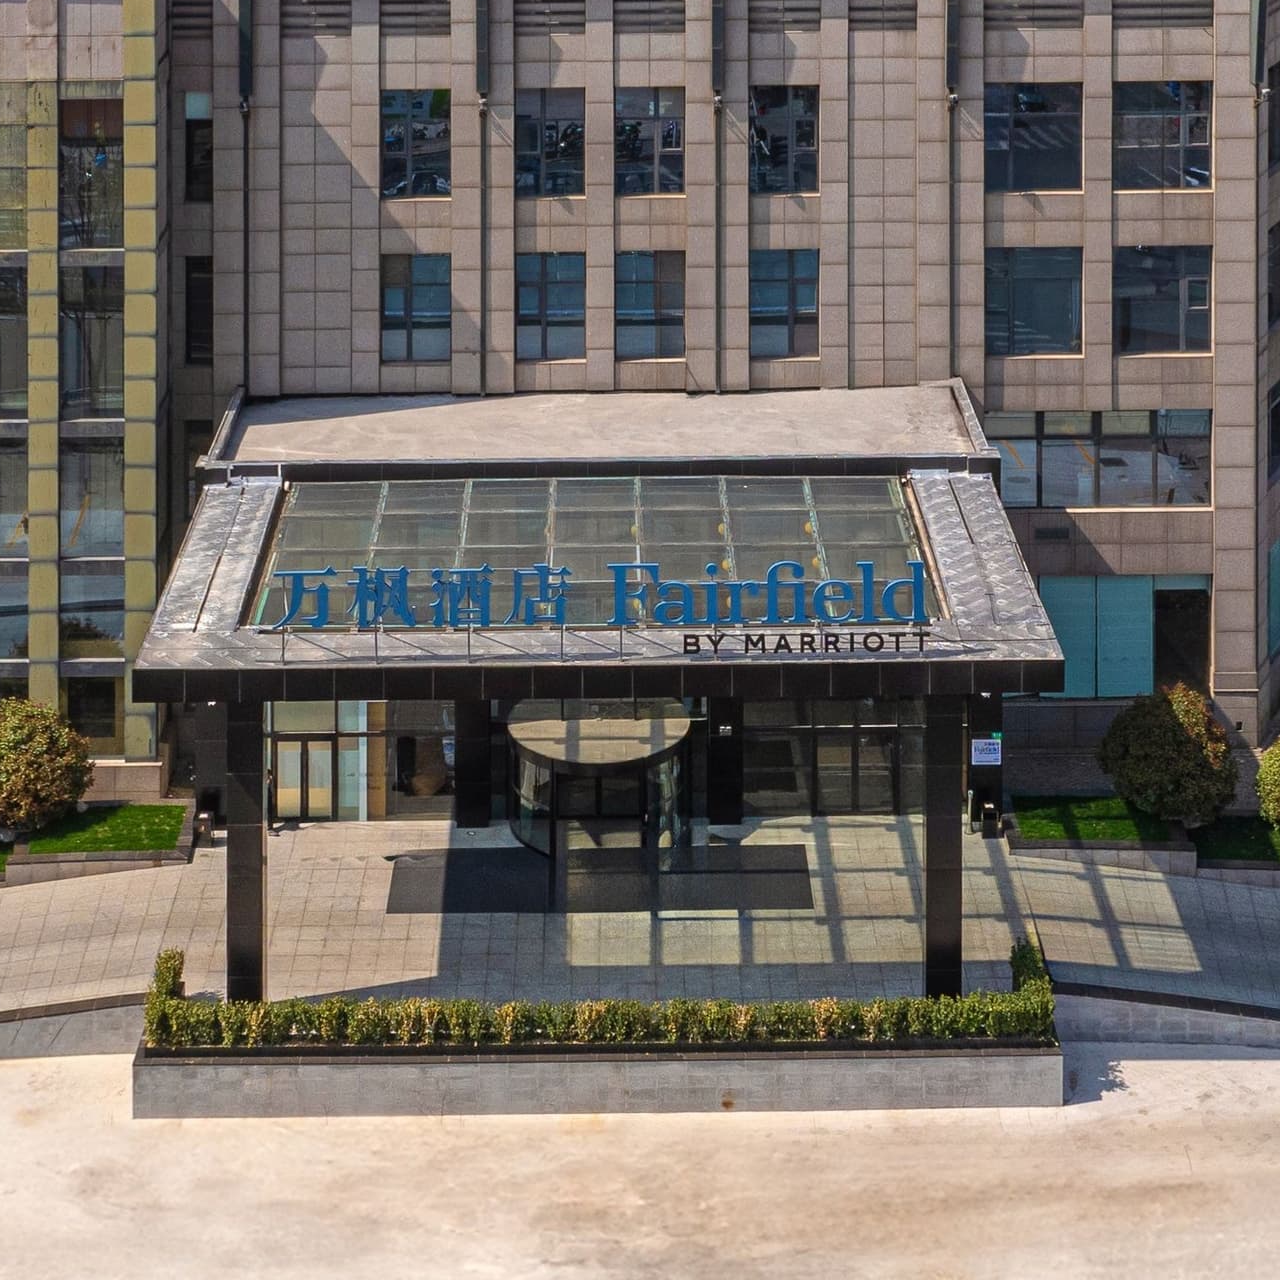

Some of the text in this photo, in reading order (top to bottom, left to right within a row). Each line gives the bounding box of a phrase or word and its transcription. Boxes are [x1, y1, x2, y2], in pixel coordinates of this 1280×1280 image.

[271, 560, 927, 630] 万枫酒店 Fairfield
[682, 631, 932, 655] BY MARRIOTT
